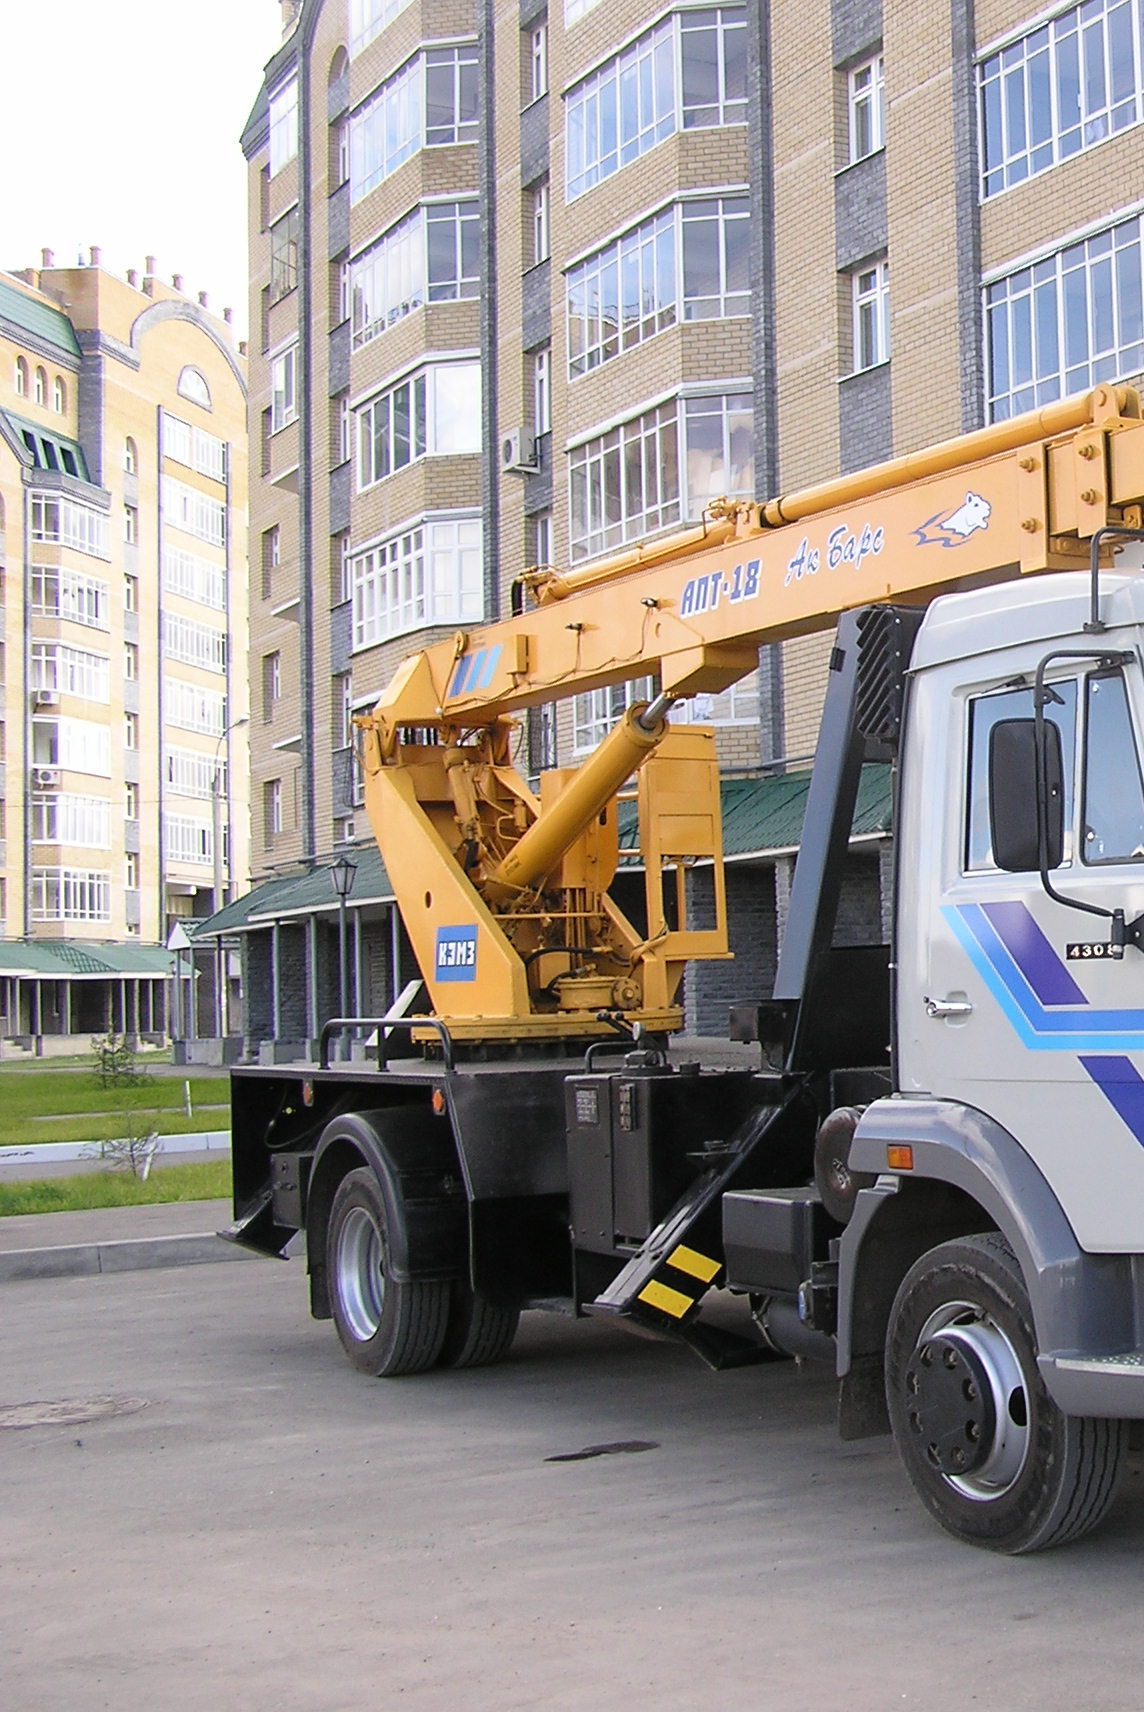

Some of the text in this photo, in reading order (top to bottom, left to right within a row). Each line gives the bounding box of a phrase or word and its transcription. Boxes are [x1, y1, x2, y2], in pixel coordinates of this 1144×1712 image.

[680, 558, 762, 618] АПТ-18
[827, 523, 884, 569] Барс
[438, 940, 475, 966] КЭМЗ
